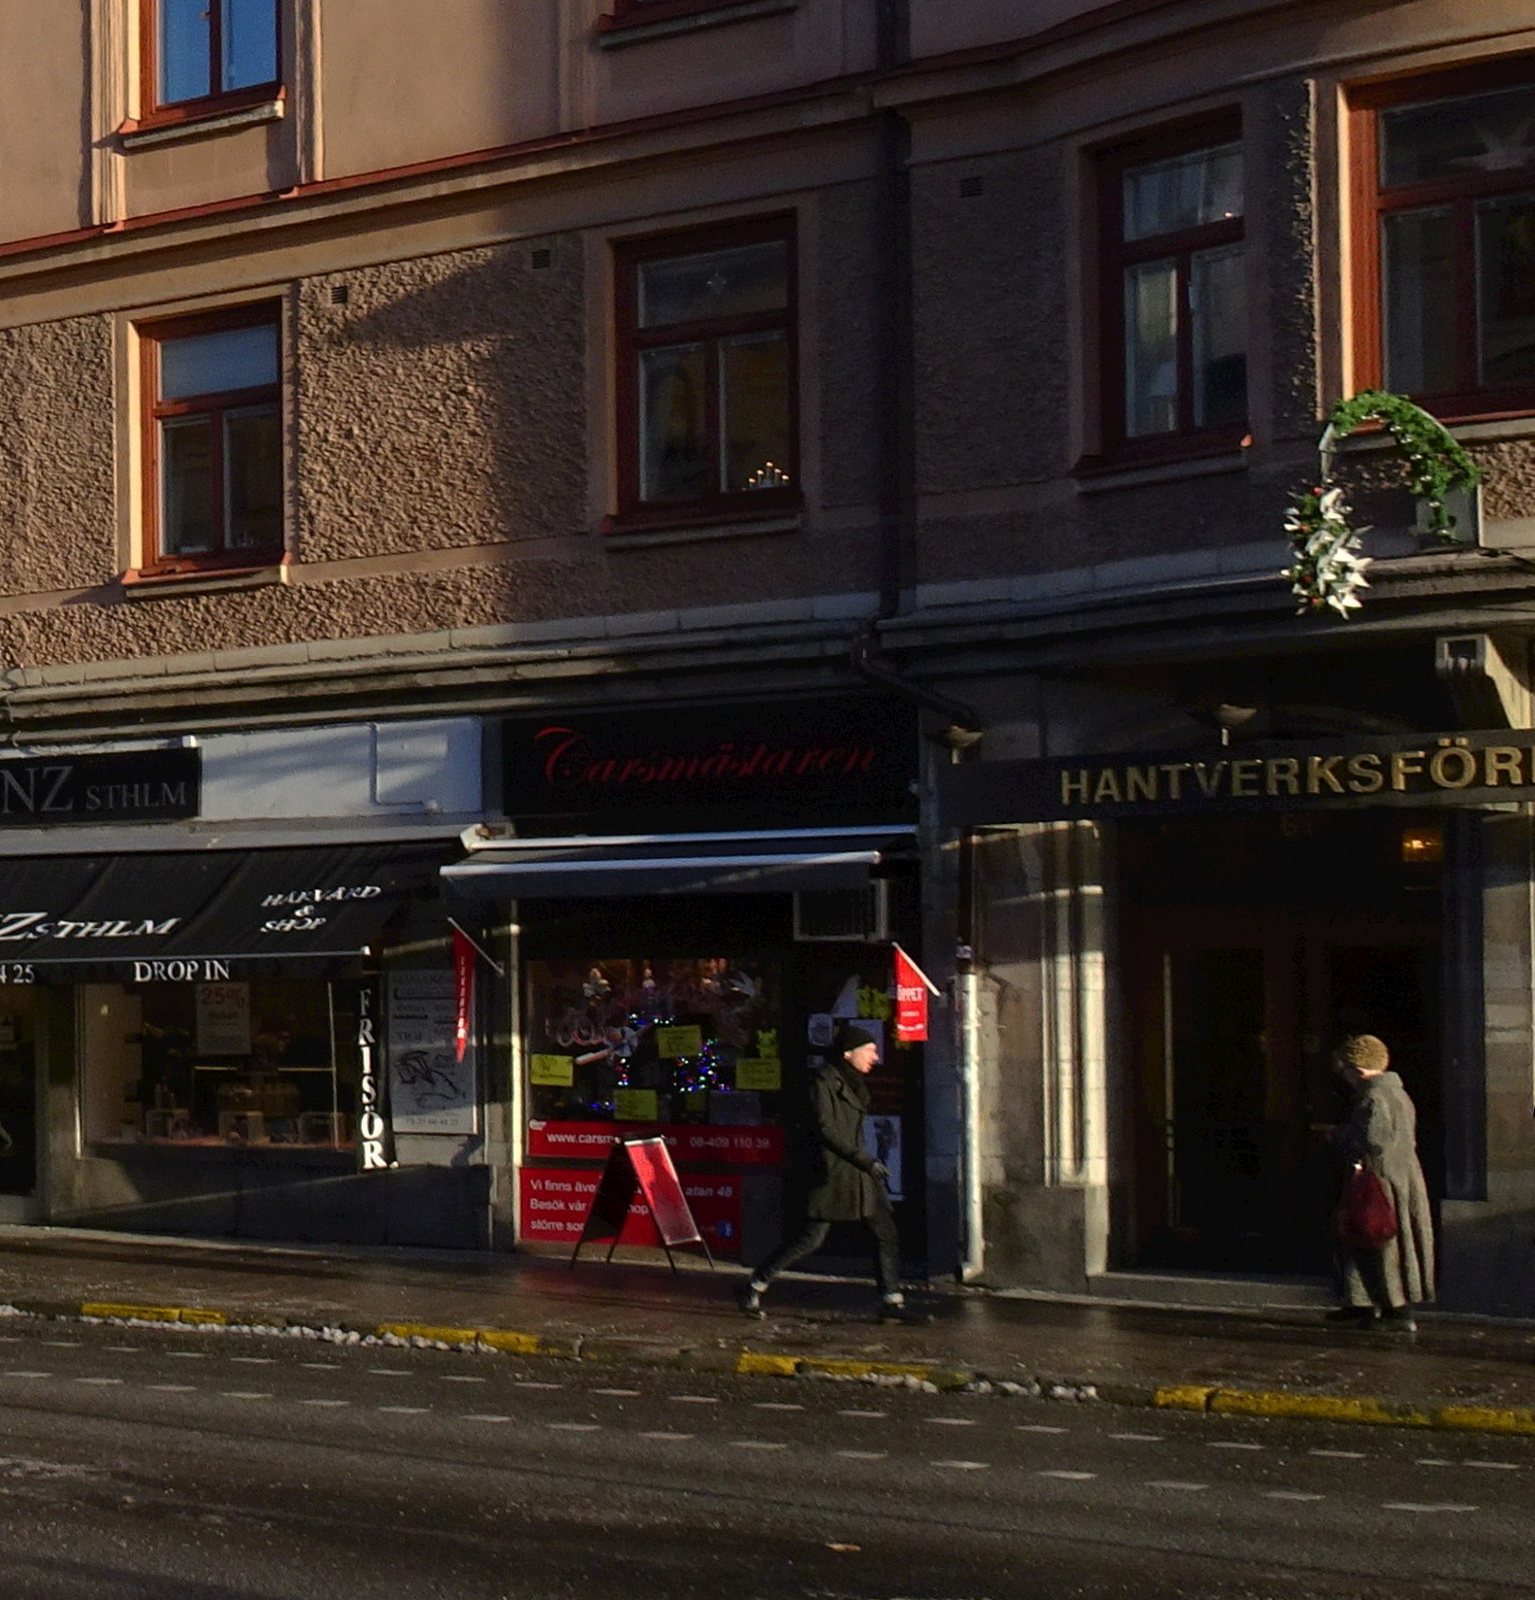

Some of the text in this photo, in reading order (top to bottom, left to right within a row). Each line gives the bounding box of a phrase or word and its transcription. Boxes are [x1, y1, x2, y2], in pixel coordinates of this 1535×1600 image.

[1060, 736, 1535, 806] HANTVERKSFÖR
[85, 781, 187, 811] STHLM
[31, 917, 182, 940] STHLM
[13, 963, 36, 984] 25
[134, 959, 231, 982] DROP IN
[357, 988, 388, 1170] FRISÖR
[530, 1179, 597, 1193] Vi finns äve
[530, 1198, 587, 1212] Besök vår
[530, 1219, 564, 1232] större
